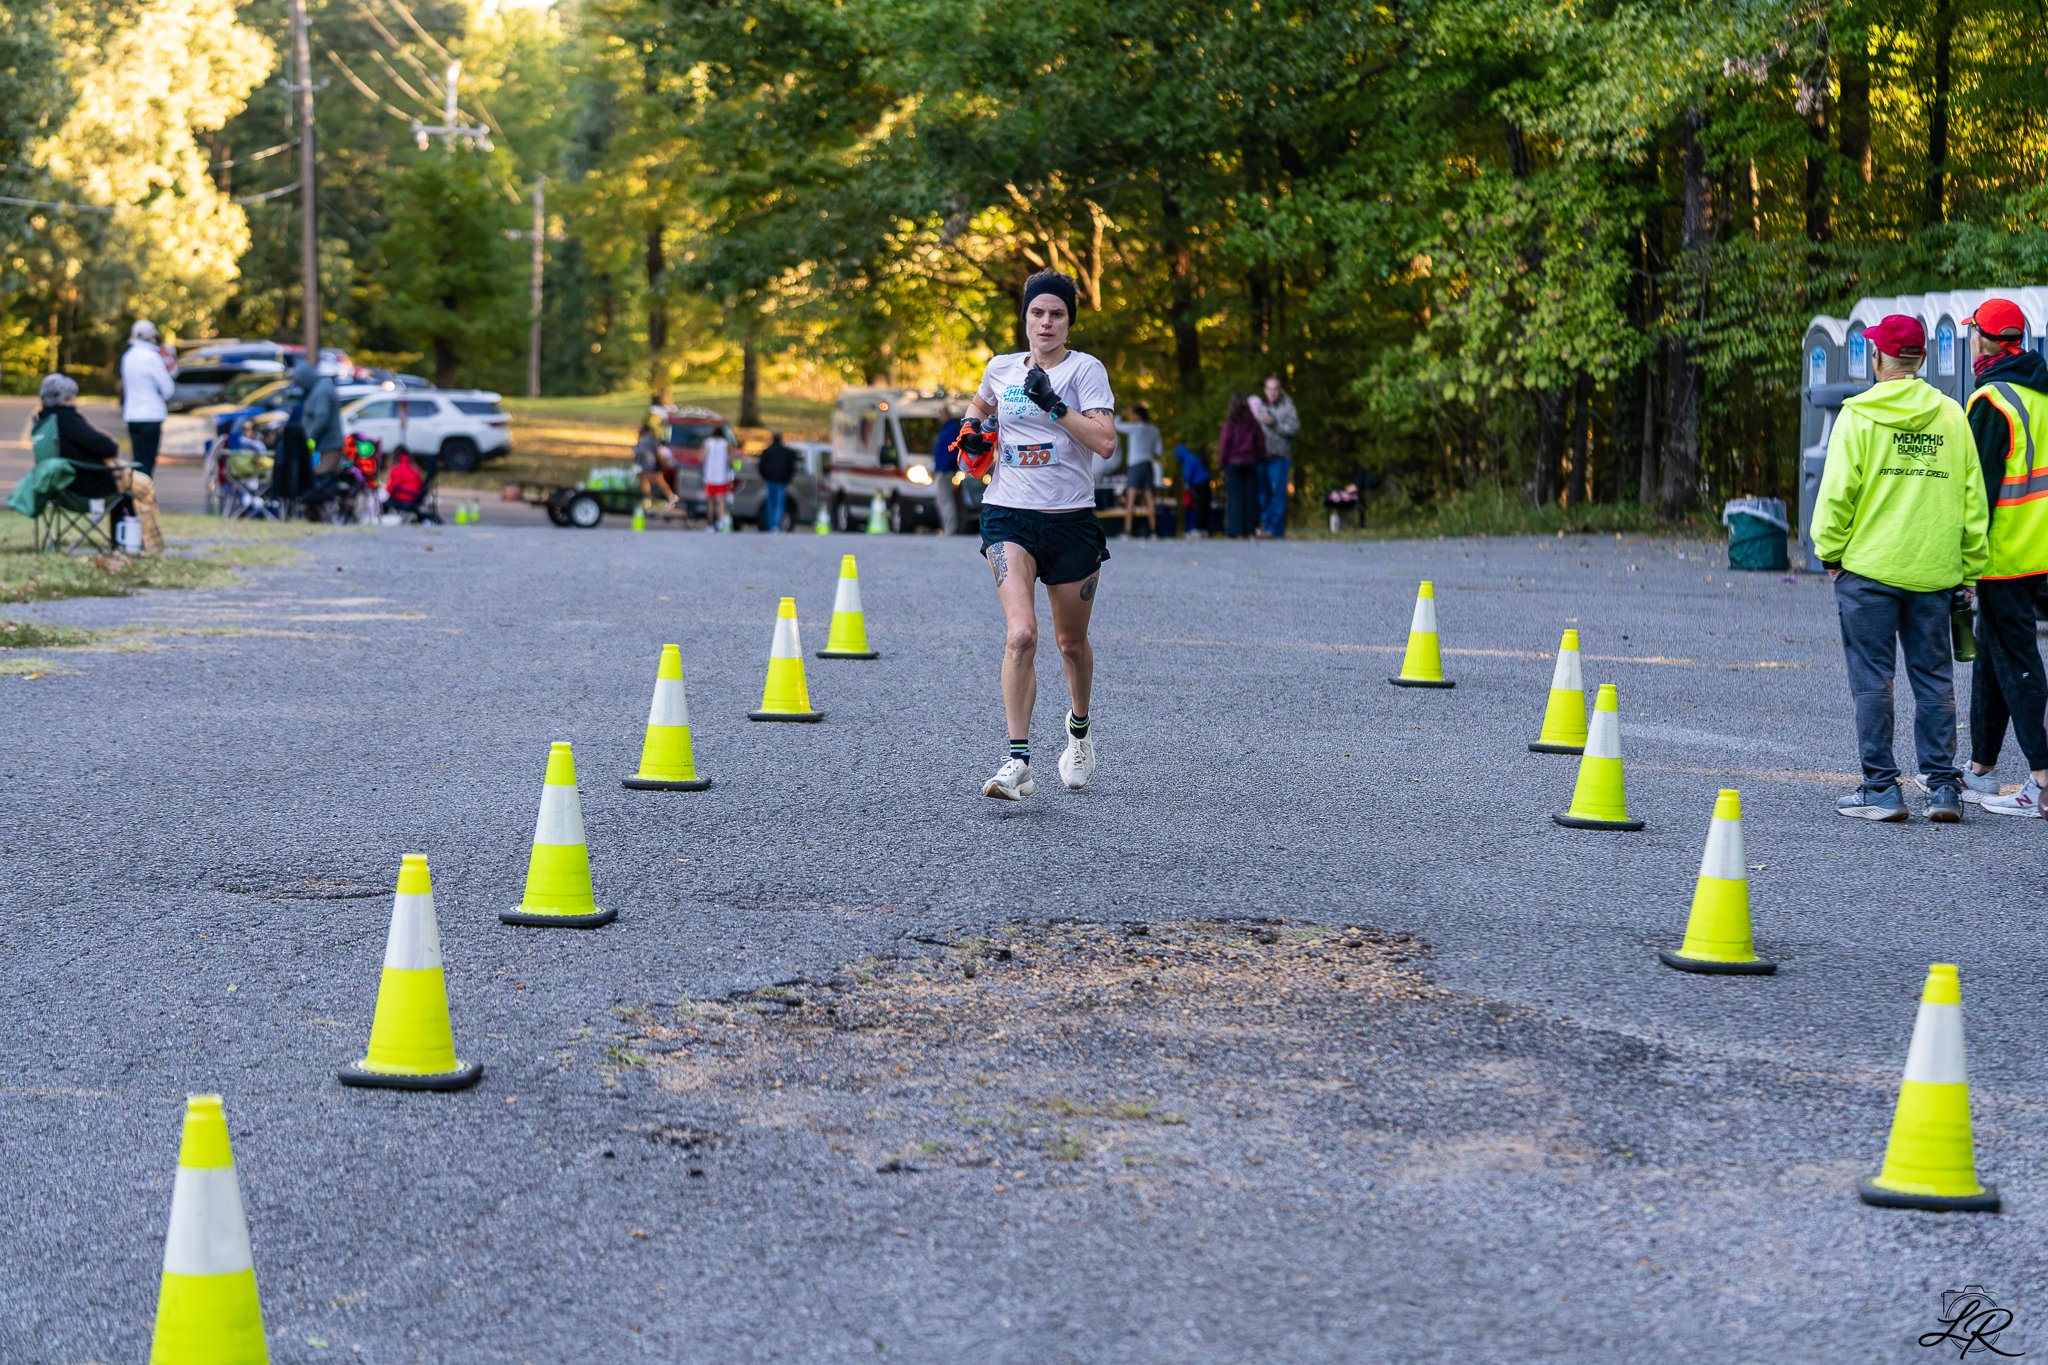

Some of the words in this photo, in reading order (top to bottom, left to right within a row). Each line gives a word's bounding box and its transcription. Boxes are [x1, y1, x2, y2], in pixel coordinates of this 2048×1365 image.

[1893, 433, 1944, 446] MEMPHIS
[1898, 444, 1937, 454] RUNNERS
[1019, 450, 1051, 465] 229
[1926, 469, 1950, 479] CREW
